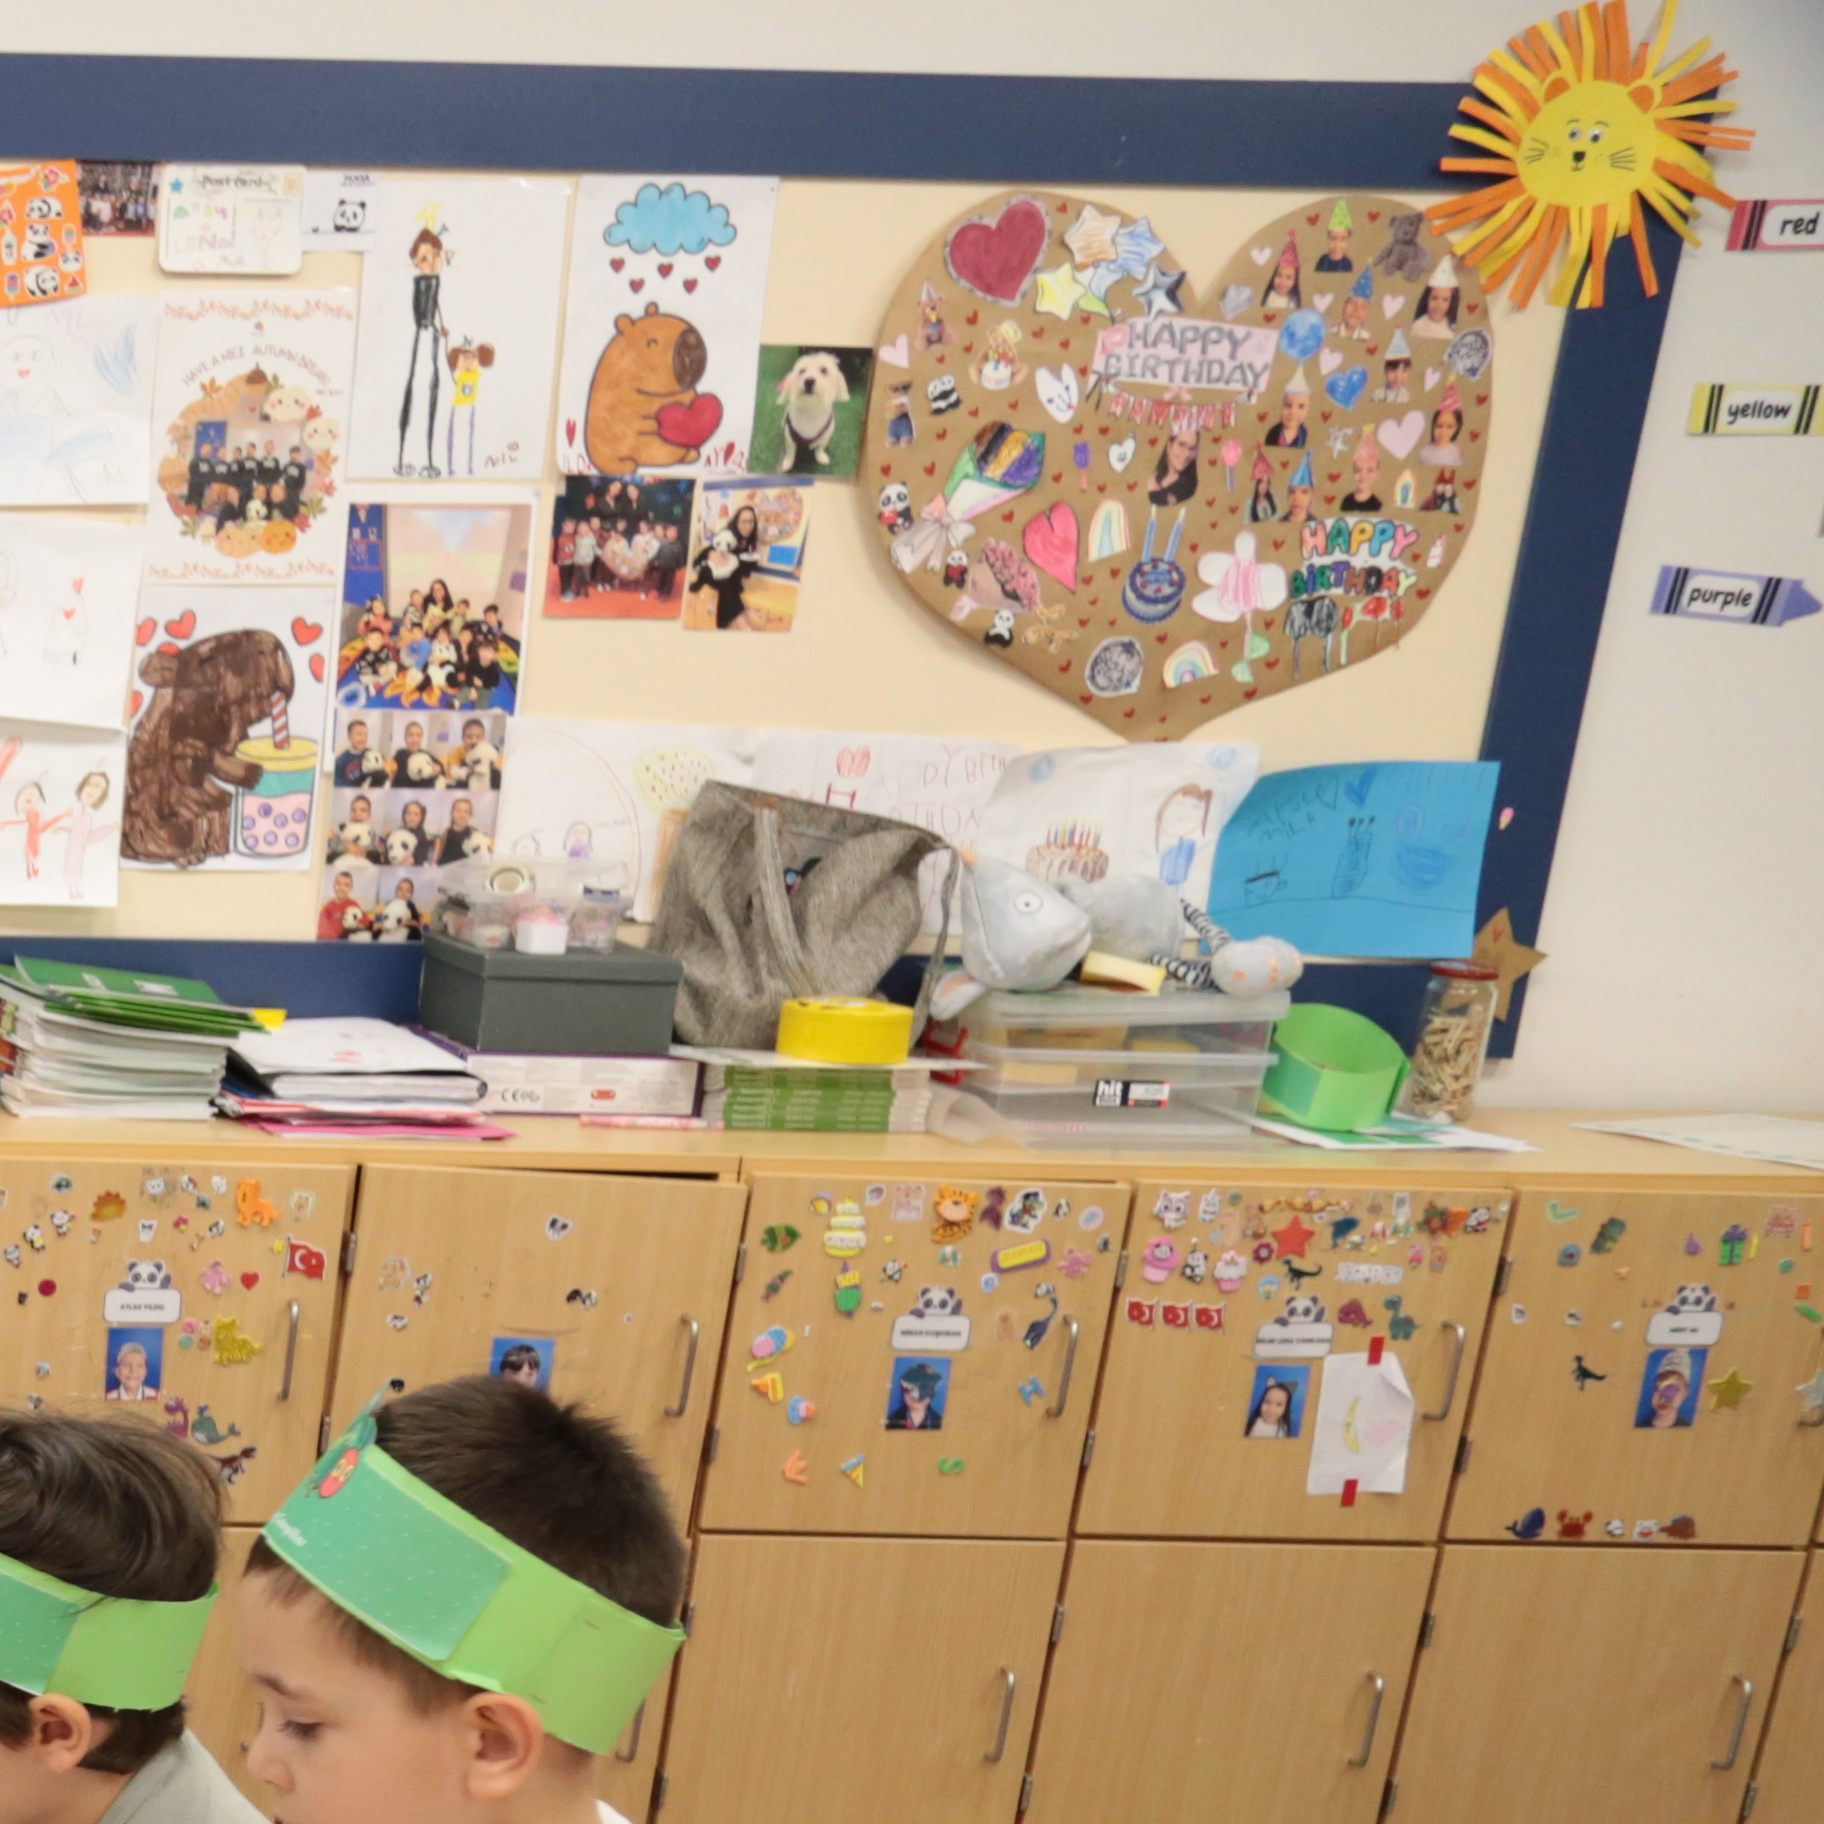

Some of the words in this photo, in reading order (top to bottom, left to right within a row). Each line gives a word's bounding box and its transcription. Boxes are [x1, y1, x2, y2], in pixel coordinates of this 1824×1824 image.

[1780, 212, 1820, 236] red
[1128, 320, 1252, 361] HAPPY
[1104, 353, 1270, 390] BIRTHDAY
[1727, 399, 1791, 426] yellow
[1301, 517, 1419, 560] HAPPY
[1688, 585, 1753, 612] purple
